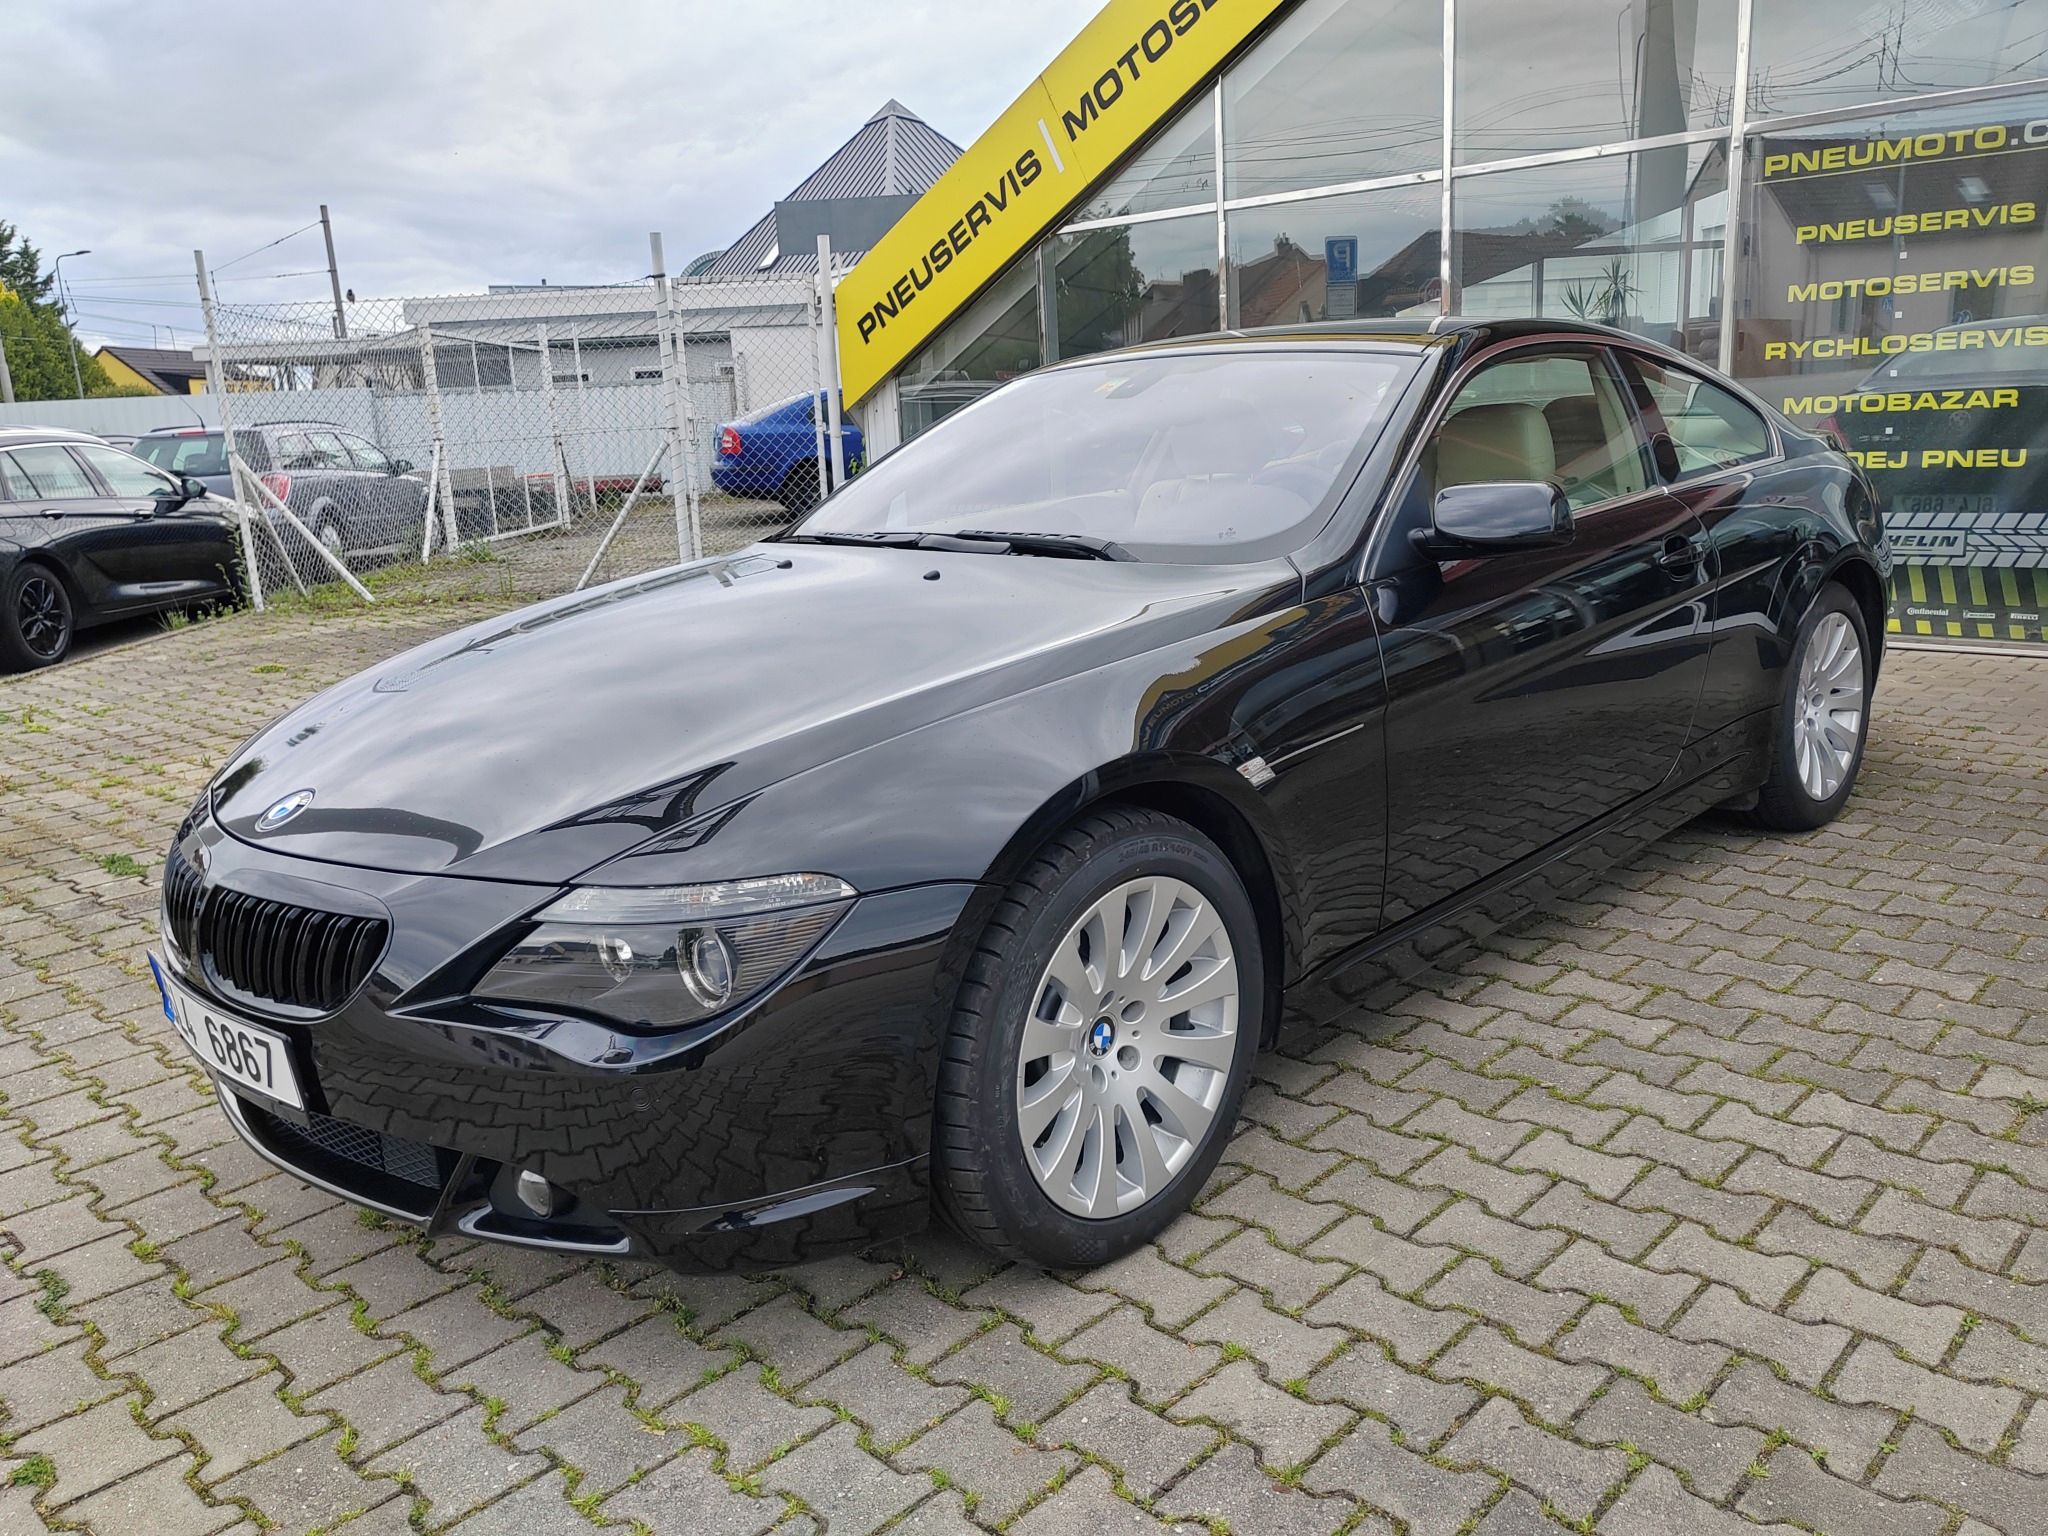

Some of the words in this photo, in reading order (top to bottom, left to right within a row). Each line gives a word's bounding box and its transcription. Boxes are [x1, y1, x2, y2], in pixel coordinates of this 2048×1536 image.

[855, 148, 1043, 345] PNEUSERVIS
[1061, 0, 1217, 142] MOTOS
[1796, 202, 2036, 245] PNEUSERVIS
[1787, 265, 2035, 303] MOTOSERVIS
[1764, 326, 2048, 360] RYCHLOSERVIS
[1783, 389, 2019, 415] MOTOBAZAR
[1846, 450, 1908, 469] DEJ
[1921, 449, 2027, 469] PNEU
[1887, 535, 1959, 547] HELIN
[1906, 607, 1949, 616] Continental
[204, 1015, 273, 1089] 6867
